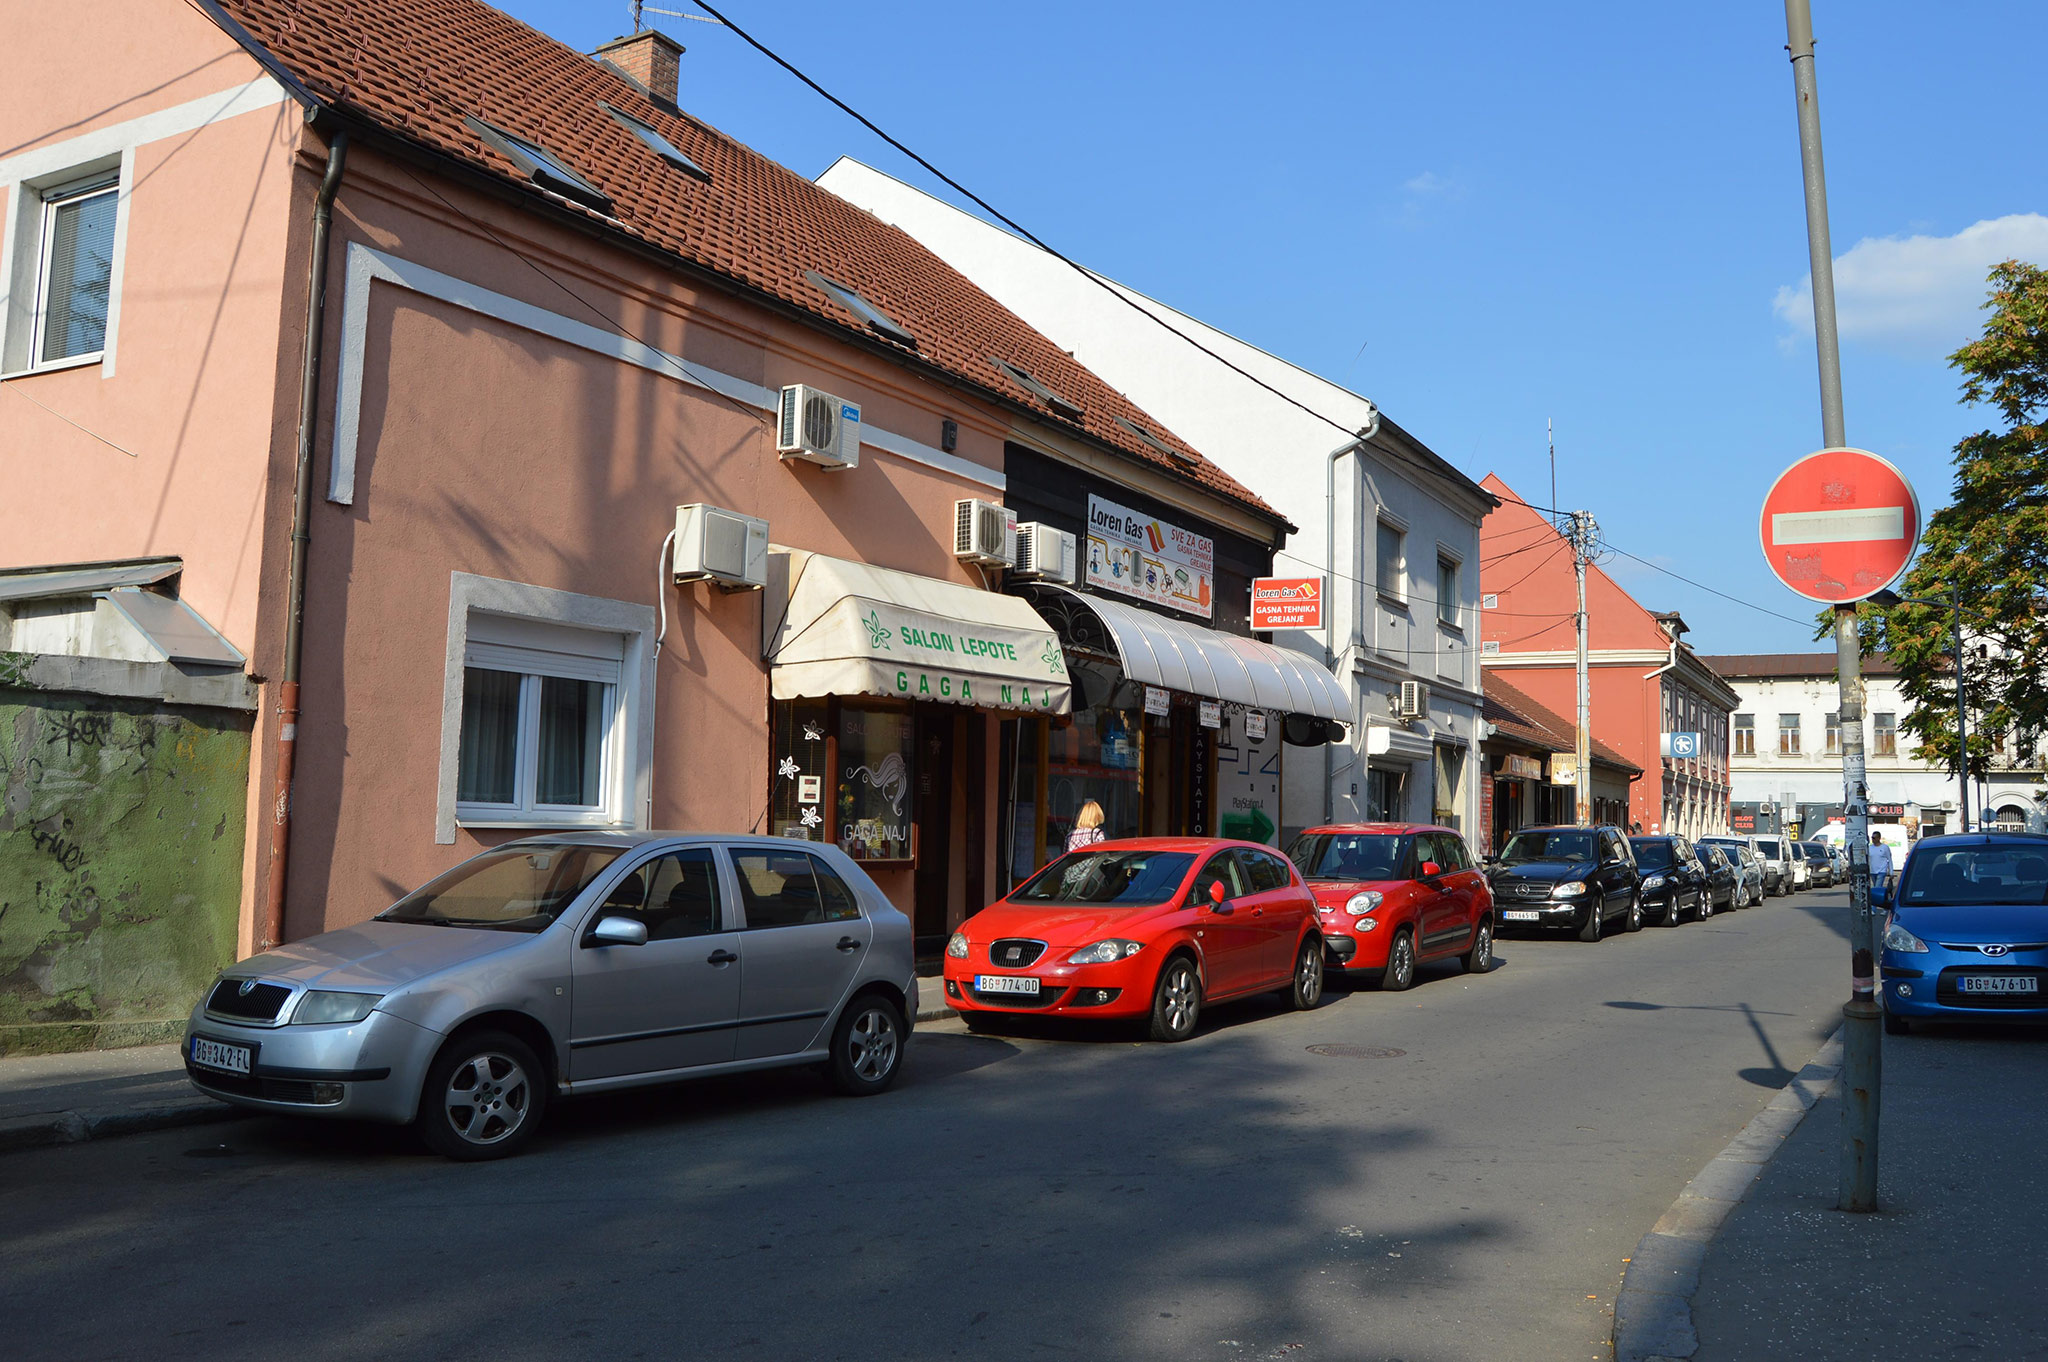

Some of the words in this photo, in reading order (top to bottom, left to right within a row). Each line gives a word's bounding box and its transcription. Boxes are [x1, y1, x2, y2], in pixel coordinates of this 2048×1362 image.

[1090, 503, 1122, 533] Loren
[1124, 516, 1143, 540] Gas
[1171, 528, 1184, 544] SVE
[1186, 534, 1196, 548] ZA
[1198, 539, 1212, 553] GAS
[1177, 544, 1193, 558] GASNA
[1193, 550, 1212, 562] TEHNIKA
[1256, 588, 1279, 598] Loren
[1281, 587, 1296, 597] Gas
[1256, 606, 1282, 614] GASNA
[1283, 605, 1316, 613] TEHNIKA
[1267, 615, 1304, 623] GREJANJE
[900, 626, 954, 652] SALON
[960, 637, 1017, 661] LEPOTE
[897, 671, 972, 699] GAGA
[1001, 685, 1049, 707] NAJ
[1879, 806, 1903, 814] CLUB
[844, 824, 878, 841] GAGA
[882, 825, 906, 841] NAJ
